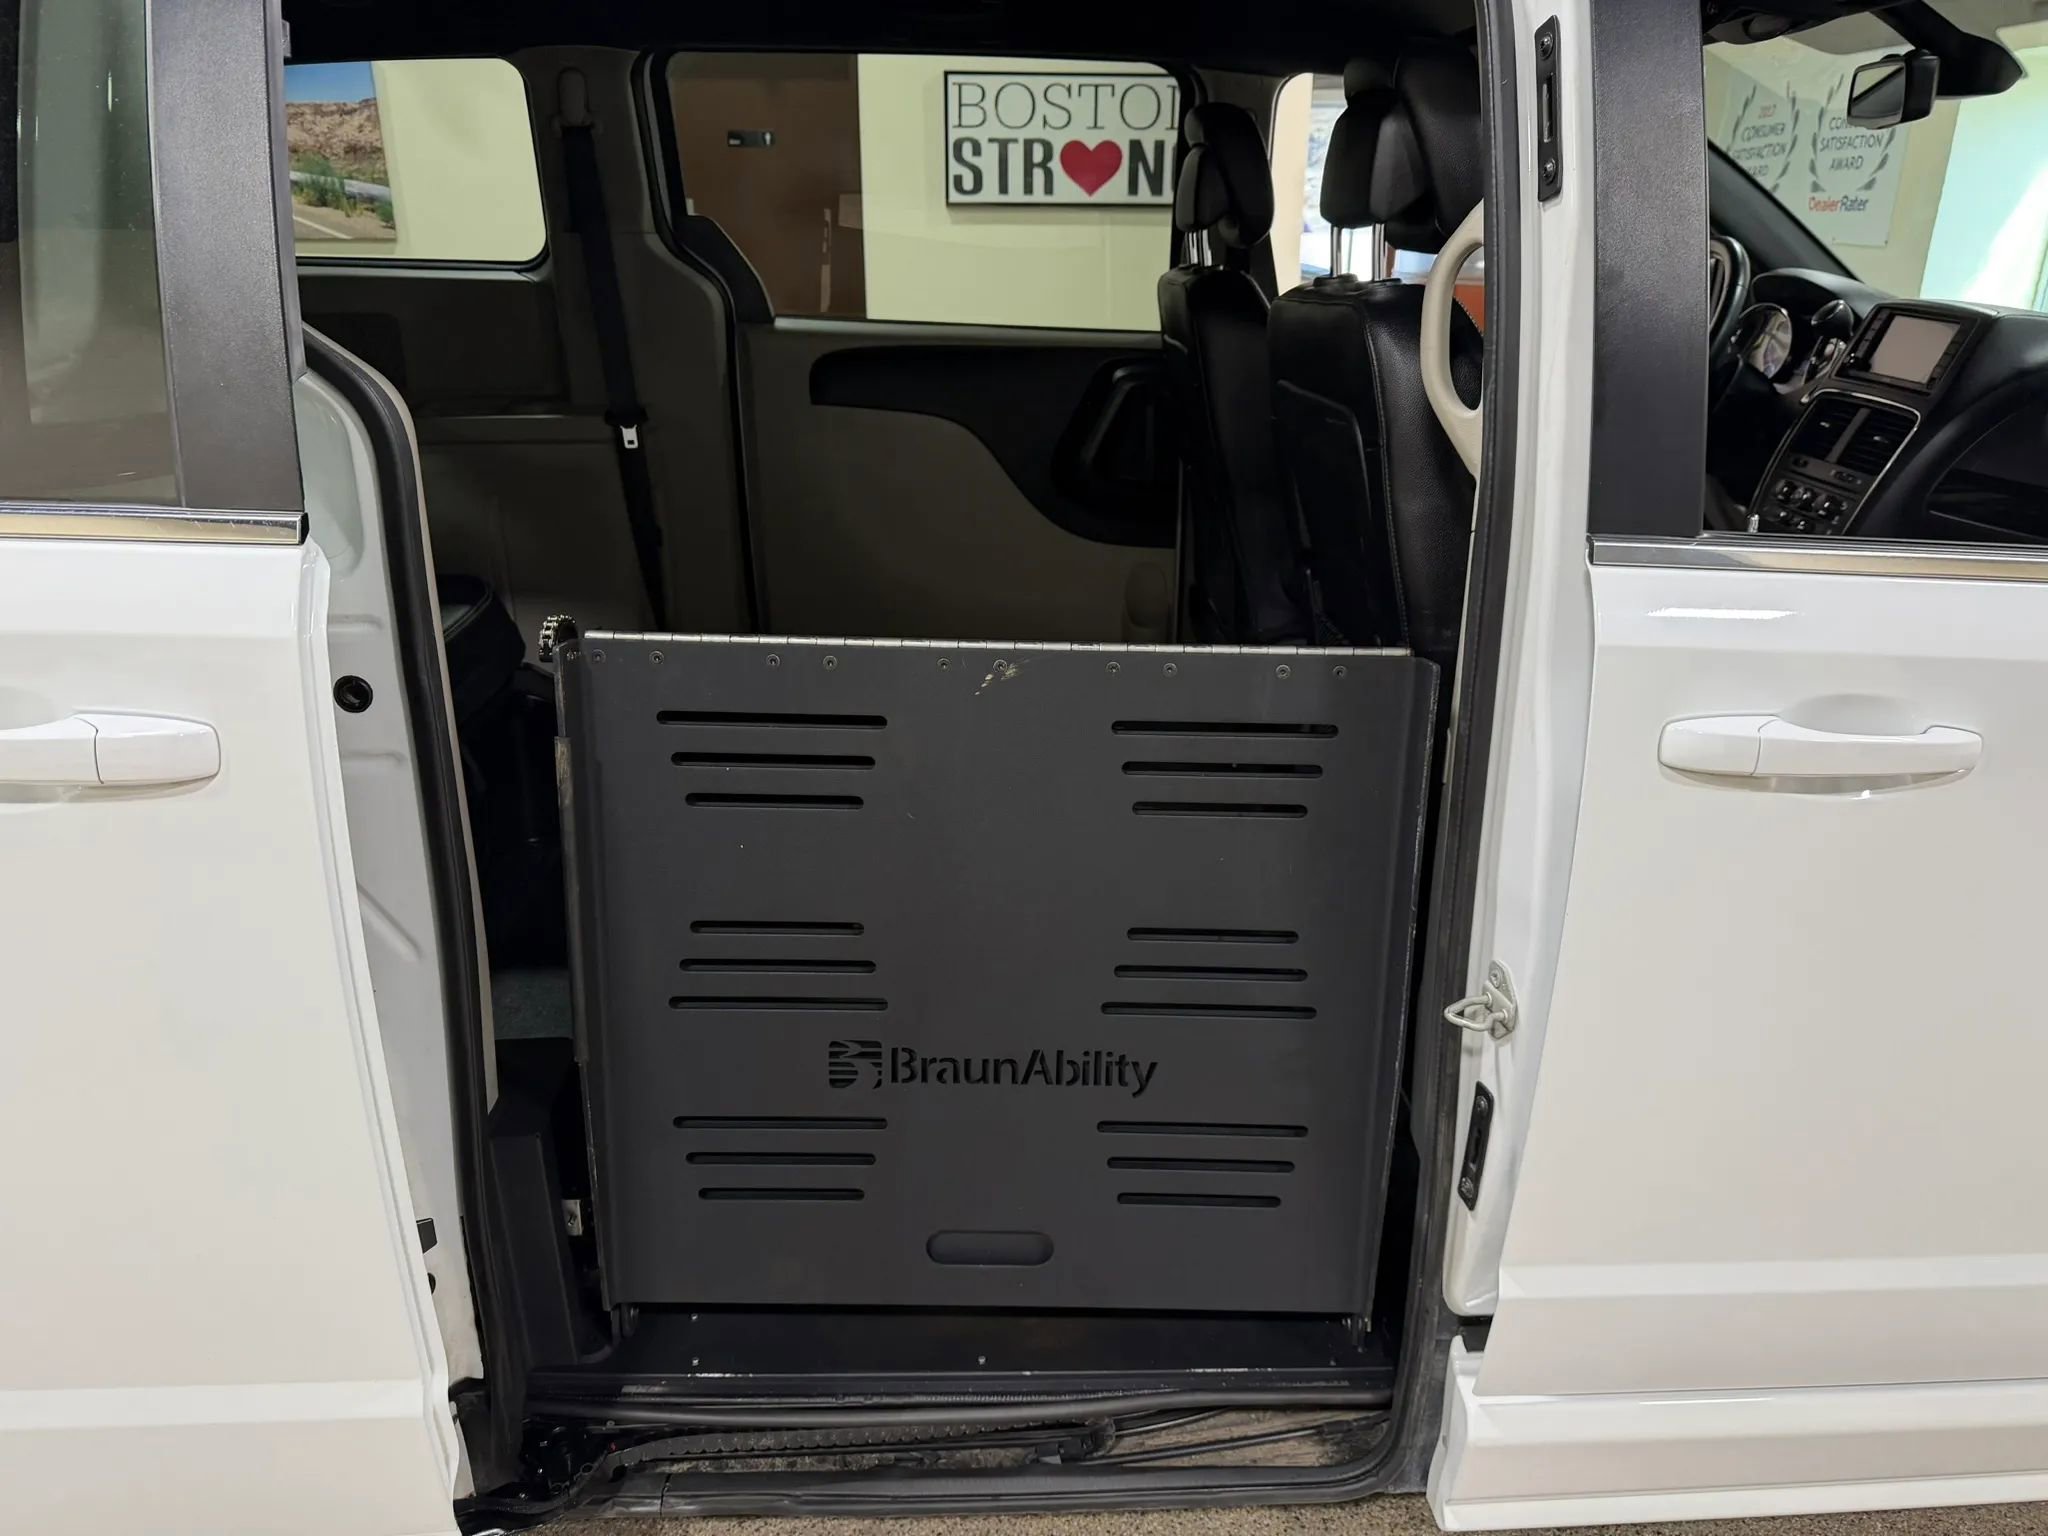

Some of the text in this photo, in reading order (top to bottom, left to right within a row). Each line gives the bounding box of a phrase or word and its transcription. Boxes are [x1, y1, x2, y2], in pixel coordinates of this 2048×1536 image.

[1820, 135, 1884, 152] SATISFACTION
[952, 137, 1178, 198] STRN
[1829, 154, 1865, 171] AWARD
[1809, 195, 1869, 212] DealerRater
[889, 1046, 1158, 1099] BraunAbility
